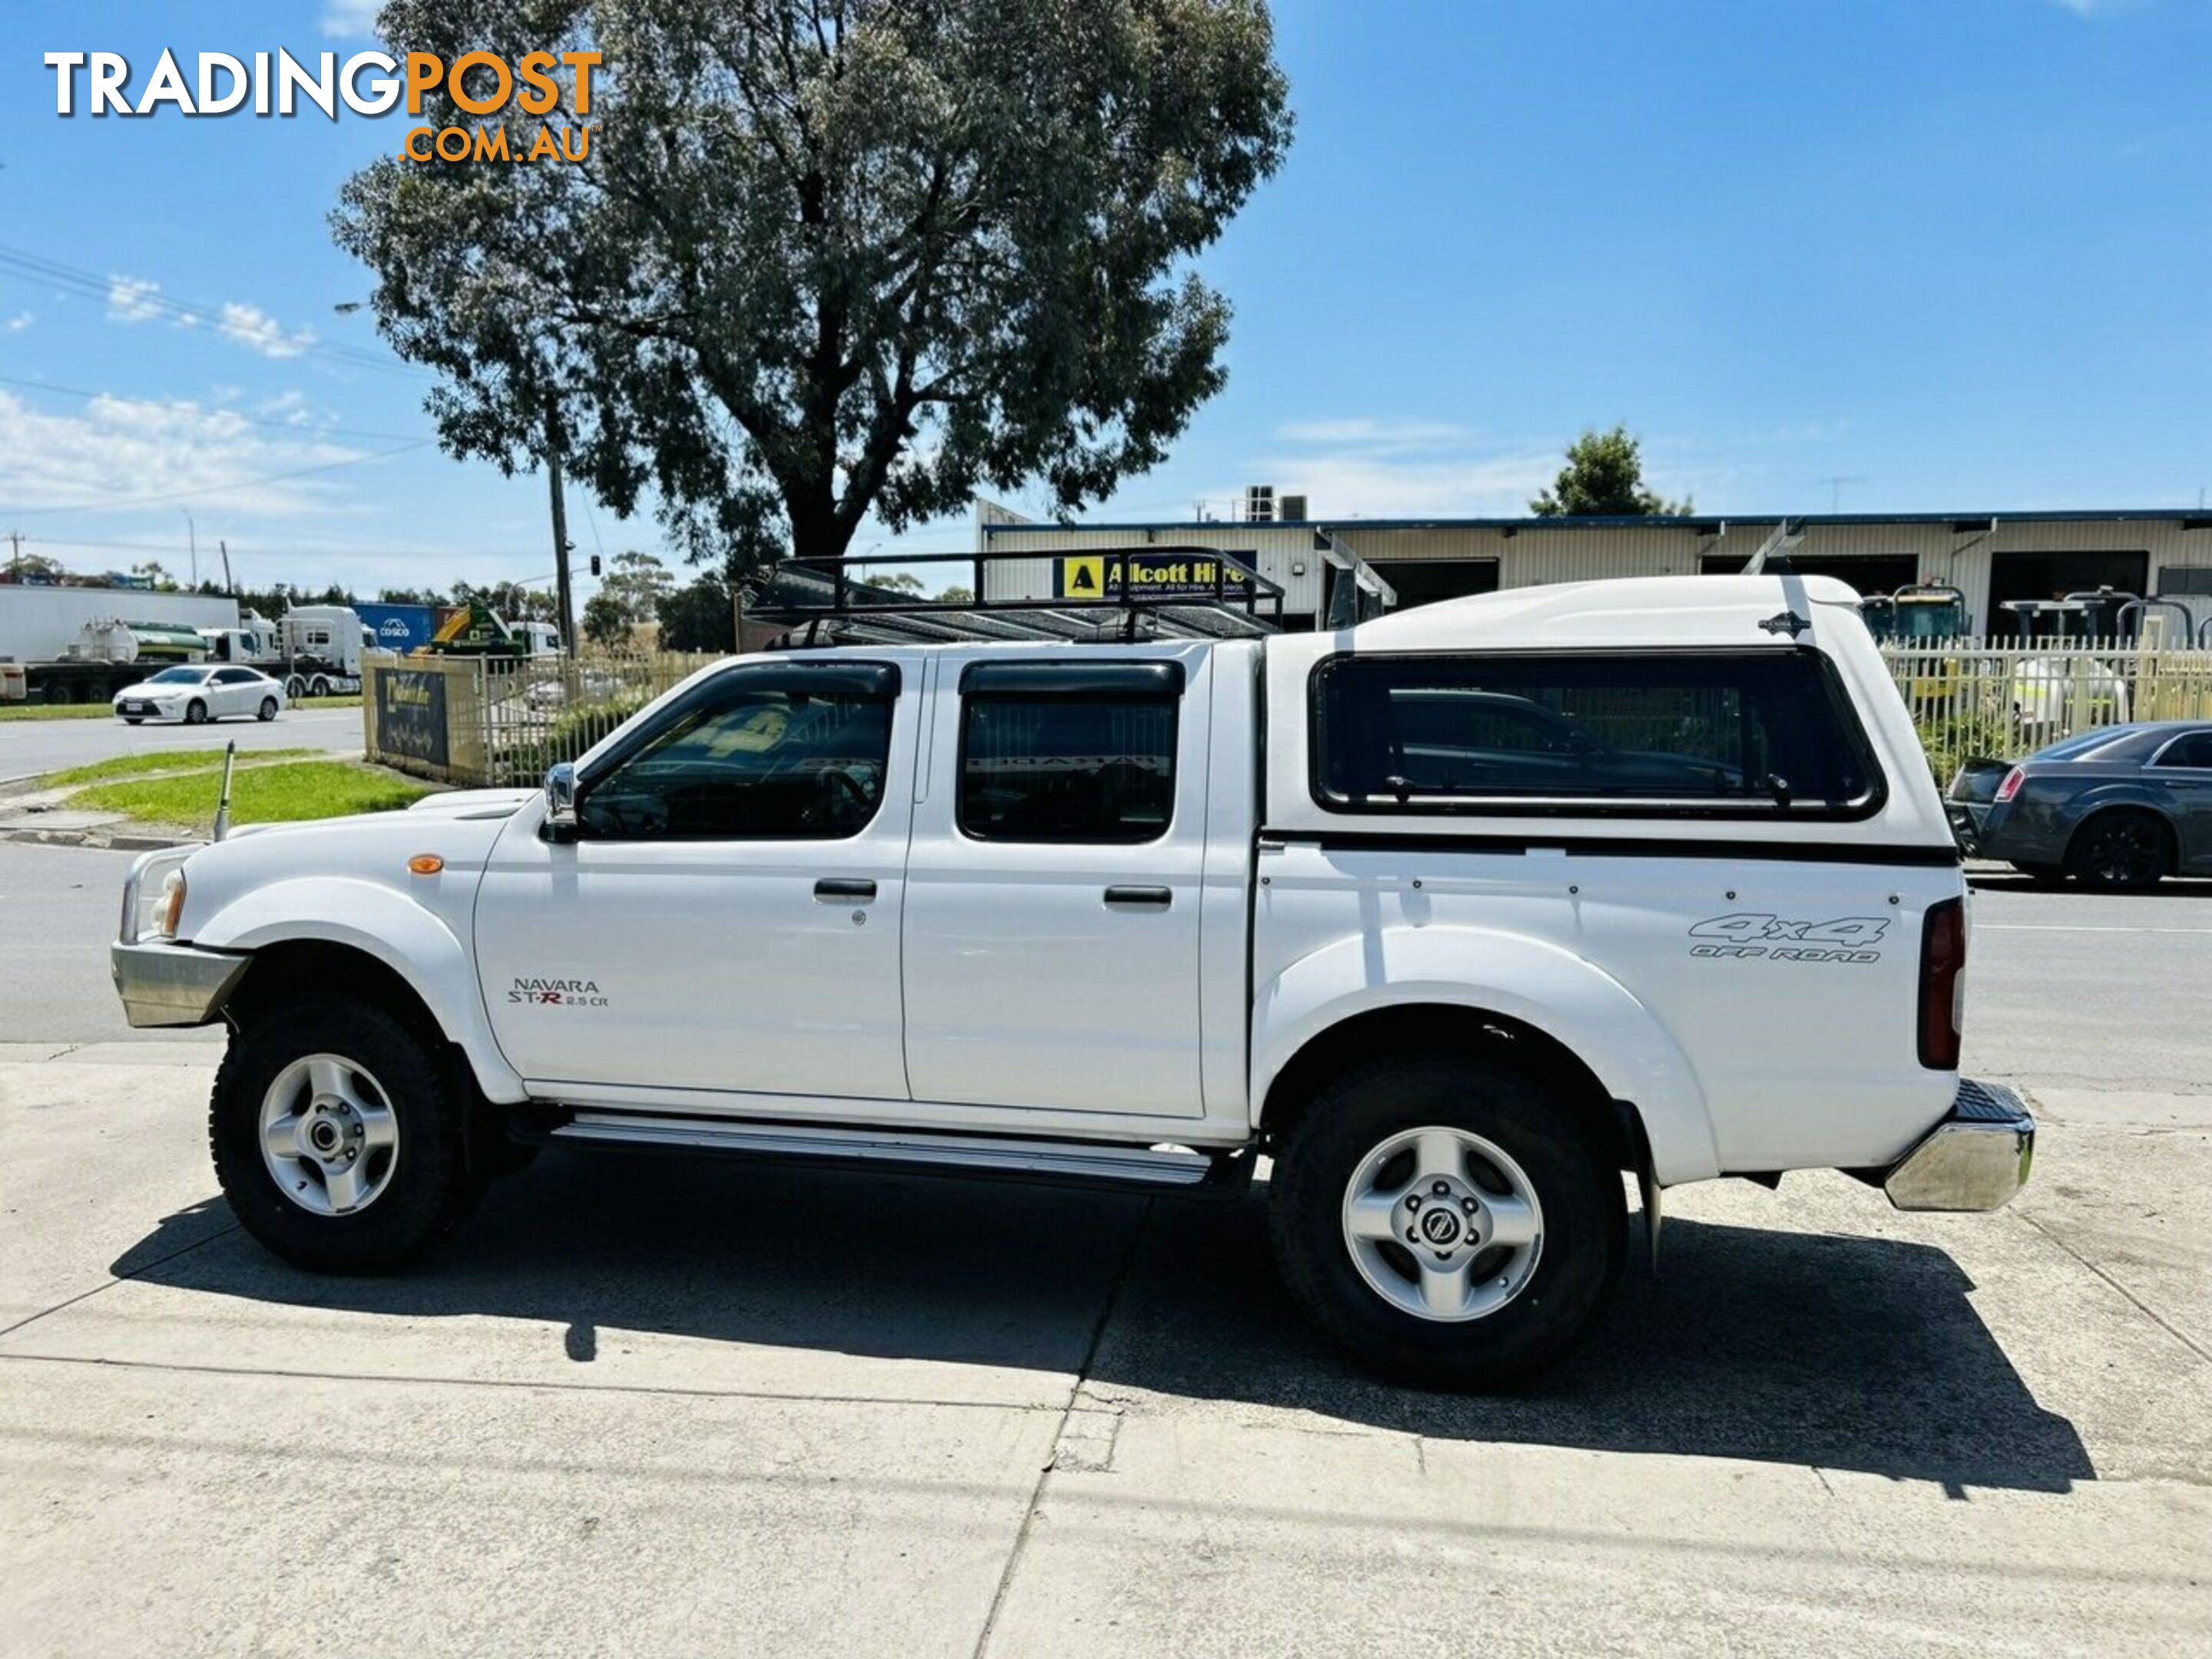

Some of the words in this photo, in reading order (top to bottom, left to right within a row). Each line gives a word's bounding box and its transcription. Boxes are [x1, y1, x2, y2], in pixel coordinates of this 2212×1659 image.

[1072, 565, 1095, 589] A
[1194, 563, 1245, 583] Hire
[379, 628, 410, 637] COSCO
[1688, 913, 1891, 947] 4x4
[1690, 945, 1767, 958] OFF
[1769, 948, 1880, 963] ROAD
[514, 978, 599, 993] NAVARA
[566, 997, 588, 1005] 2.5
[590, 998, 609, 1007] CR
